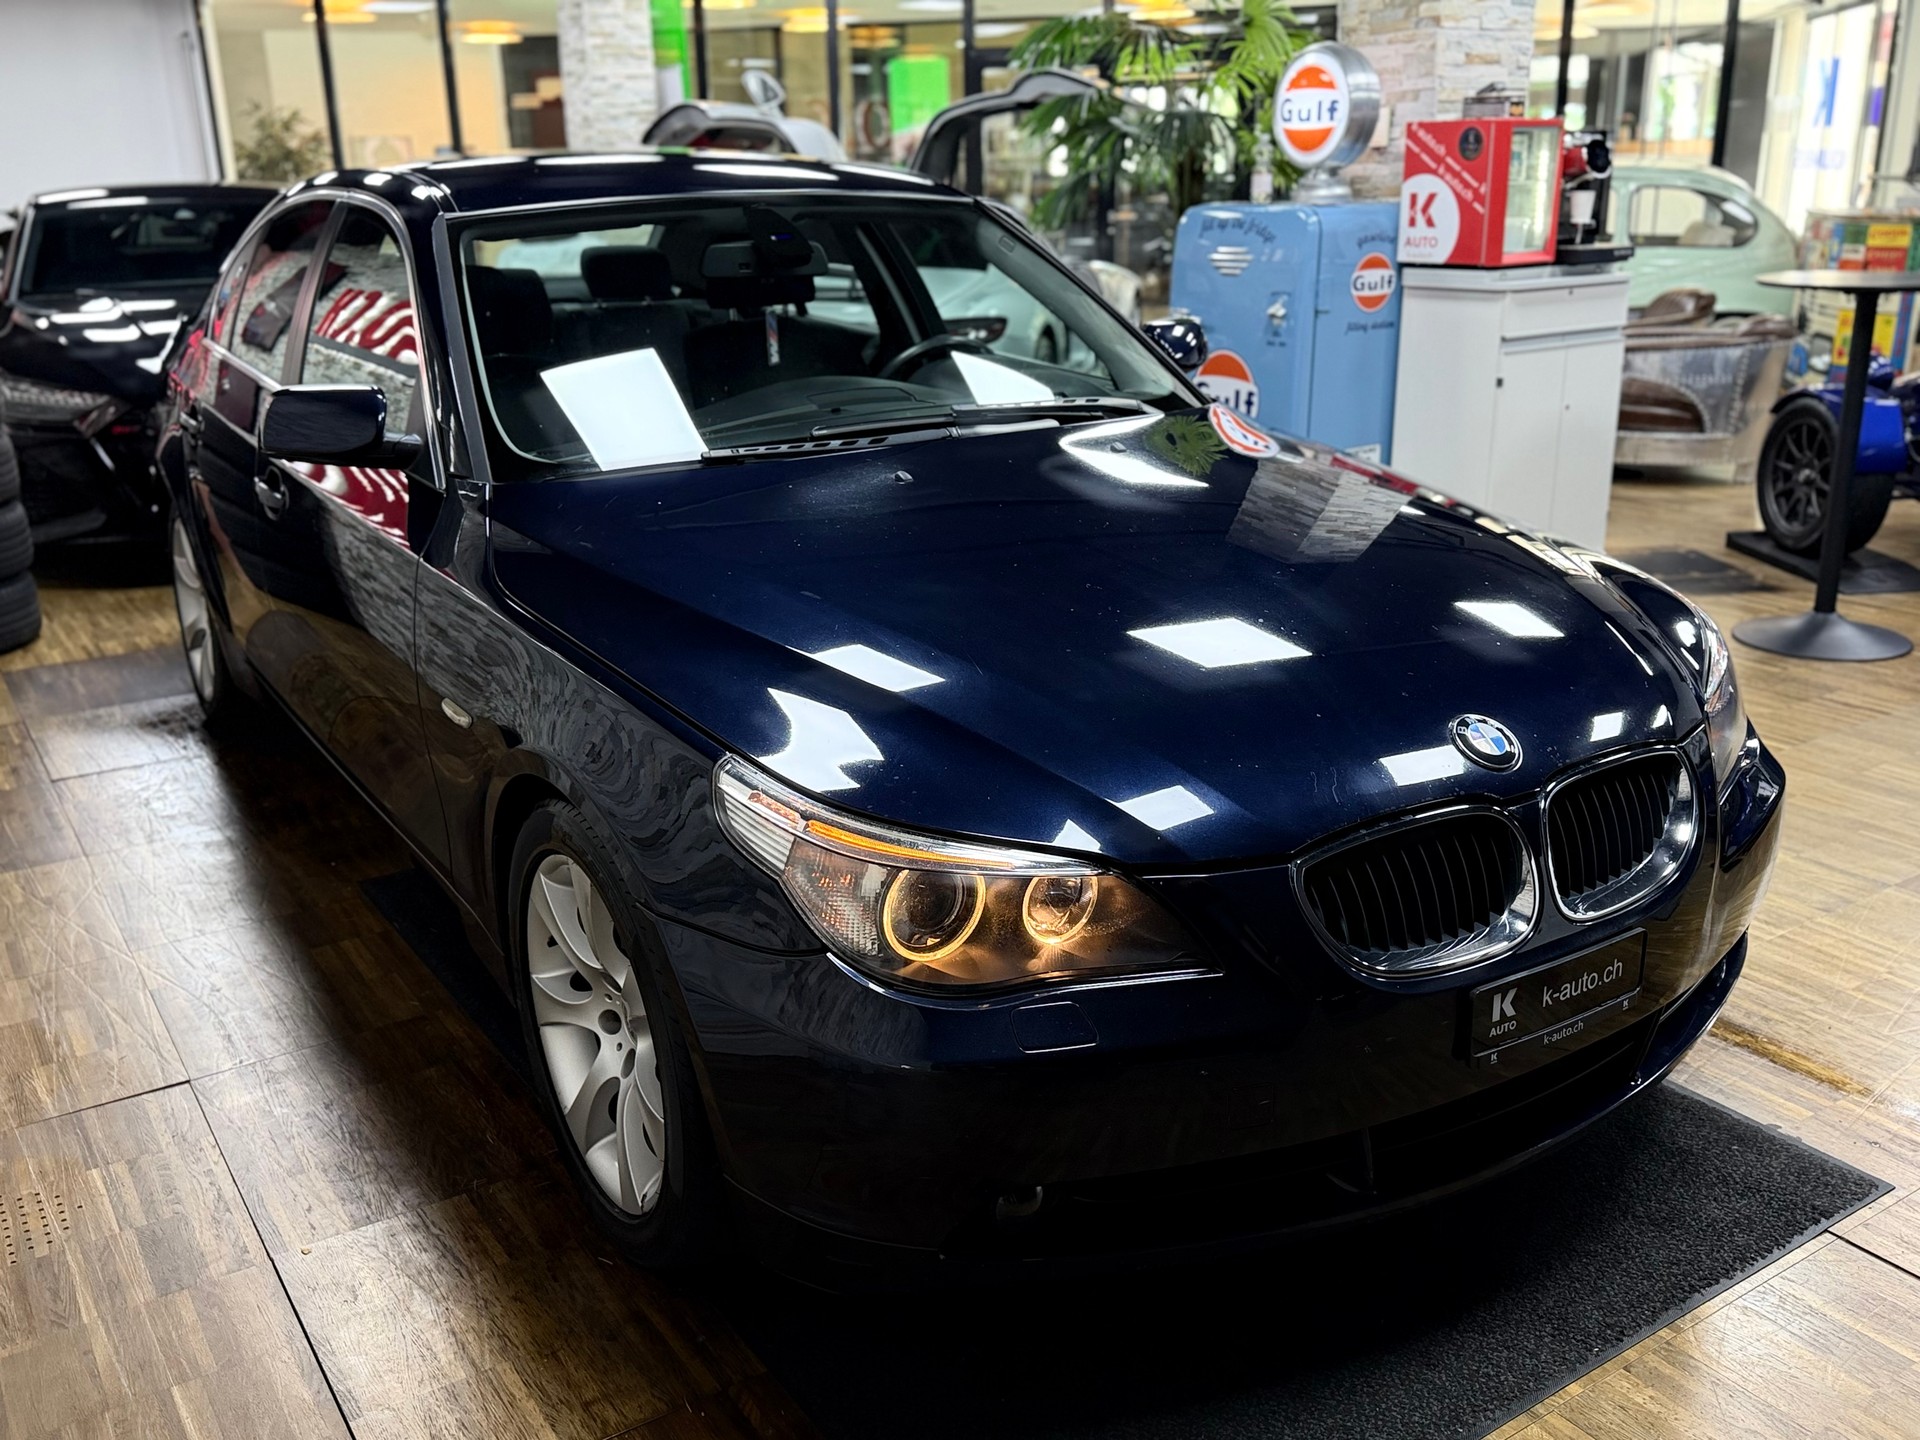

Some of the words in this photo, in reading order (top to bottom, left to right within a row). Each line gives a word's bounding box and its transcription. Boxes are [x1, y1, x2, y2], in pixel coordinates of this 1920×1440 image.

[1281, 98, 1340, 122] Gulf
[1408, 192, 1438, 229] K
[1404, 236, 1439, 249] AUTO
[1353, 274, 1393, 292] Gulf
[1542, 958, 1623, 1008] k-auto.ch
[1492, 987, 1518, 1023] K
[1489, 1020, 1517, 1038] AUTO
[1543, 1021, 1584, 1045] k-auto.ch
